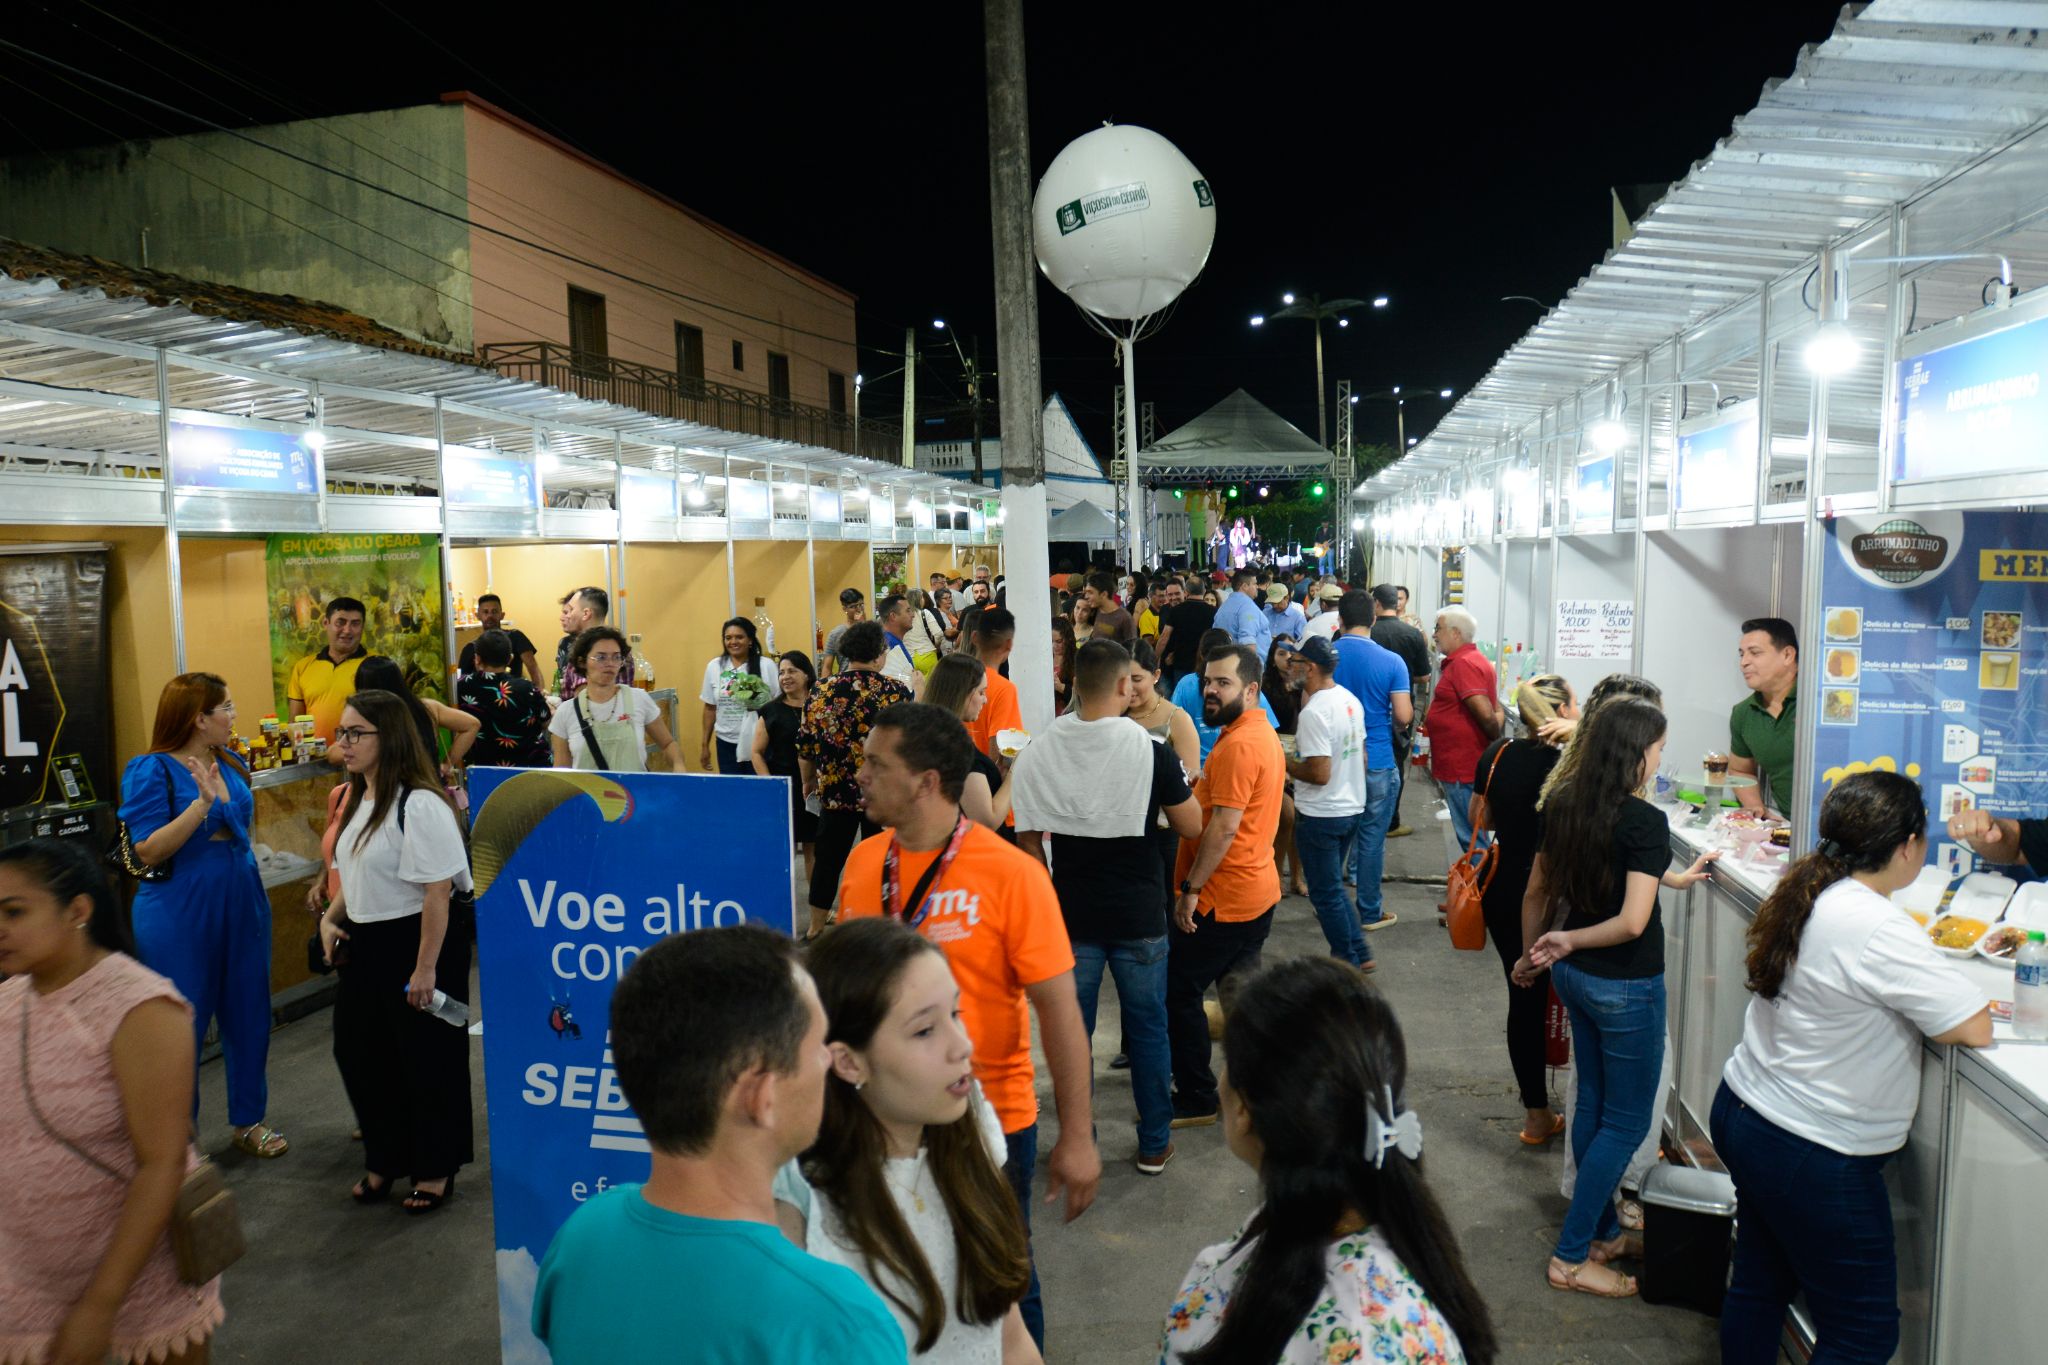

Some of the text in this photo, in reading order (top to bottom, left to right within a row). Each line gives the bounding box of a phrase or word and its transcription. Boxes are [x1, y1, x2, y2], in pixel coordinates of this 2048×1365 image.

[1083, 195, 1112, 215] VIÇOSA
[1120, 186, 1147, 205] CEARÁ
[1904, 370, 1930, 389] SEBRAE
[1946, 372, 2040, 413] ARRUMADINHO
[282, 540, 299, 552] EM
[303, 537, 353, 555] VIÇOSA
[354, 536, 373, 549] DO
[1860, 536, 1940, 552] ARRUMADINHO
[383, 551, 420, 563] EVOLUÇÃO
[1893, 550, 1919, 564] Céu
[3, 692, 39, 757] L
[518, 878, 747, 936] Voe alto
[522, 1062, 632, 1112] SEB
[571, 1181, 588, 1202] e
